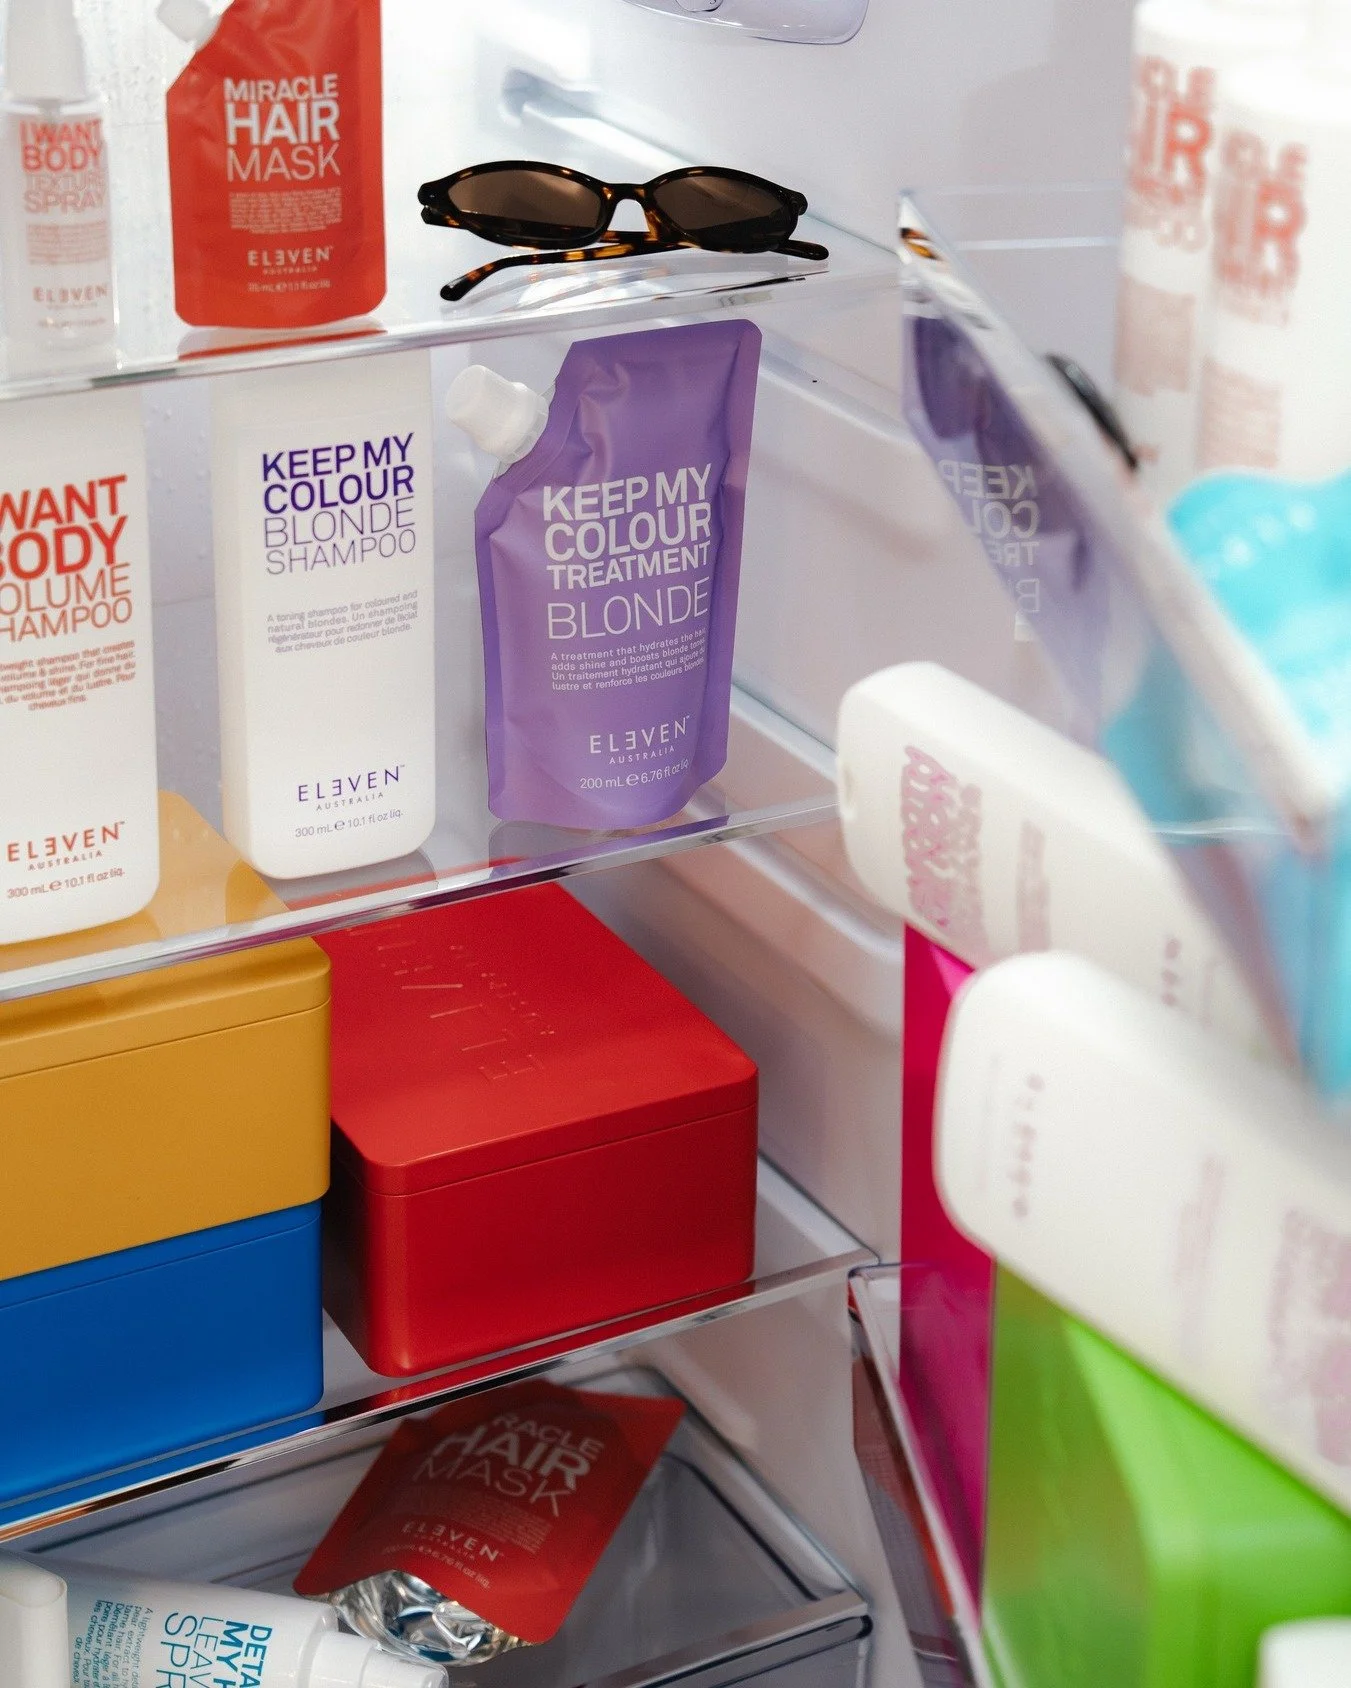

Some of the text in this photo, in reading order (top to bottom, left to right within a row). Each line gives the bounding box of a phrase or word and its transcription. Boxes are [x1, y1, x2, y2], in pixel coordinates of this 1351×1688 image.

[224, 73, 339, 102] MIRACLE
[226, 98, 340, 145] HAIR
[22, 144, 102, 173] BODY
[227, 142, 341, 182] MASK
[247, 246, 330, 267] ELEVEN
[262, 432, 415, 481] KEEP MY
[0, 474, 128, 531] WANT
[263, 465, 415, 515] COLOUR
[543, 463, 712, 521] KEEP MY
[264, 496, 416, 548] BLONDE
[544, 502, 712, 562] COLOUR
[0, 515, 129, 581] ODY
[265, 529, 416, 575] SHAMPOO
[546, 541, 711, 591] TREATMENT
[307, 605, 349, 619] shampoo
[352, 612, 366, 622] Un
[548, 576, 710, 640] BLONDE
[550, 652, 558, 661] A
[561, 649, 614, 661] treatment
[616, 645, 637, 656] that
[639, 637, 679, 653] hydrates
[681, 633, 694, 643] the
[551, 662, 576, 671] adds
[579, 661, 606, 671] shine
[609, 656, 627, 668] and
[629, 652, 660, 664] boosts
[662, 644, 689, 658] blonde
[551, 672, 565, 681] Un
[567, 668, 619, 681] traitement
[621, 660, 663, 677] hydratant
[665, 658, 678, 668] qui
[552, 681, 580, 691] lustre
[583, 681, 593, 690] et
[595, 677, 633, 689] renforce
[635, 675, 648, 684] les
[650, 666, 683, 681] couleurs
[609, 745, 675, 764] AUSTRALIA
[580, 777, 603, 789] 200
[605, 776, 624, 788] mL
[640, 768, 663, 784] 6.76
[316, 792, 384, 811] AUSTRALIA
[295, 825, 315, 838] 300
[317, 823, 334, 834] mL
[347, 816, 366, 828] 10.1
[377, 812, 388, 822] oz
[7, 886, 29, 899] 300
[432, 1424, 591, 1494] HAIR
[412, 1457, 571, 1518] MASK
[96, 1624, 106, 1645] pour
[122, 1630, 135, 1664] extract
[216, 1620, 249, 1673] MY
[112, 1654, 121, 1669] For
